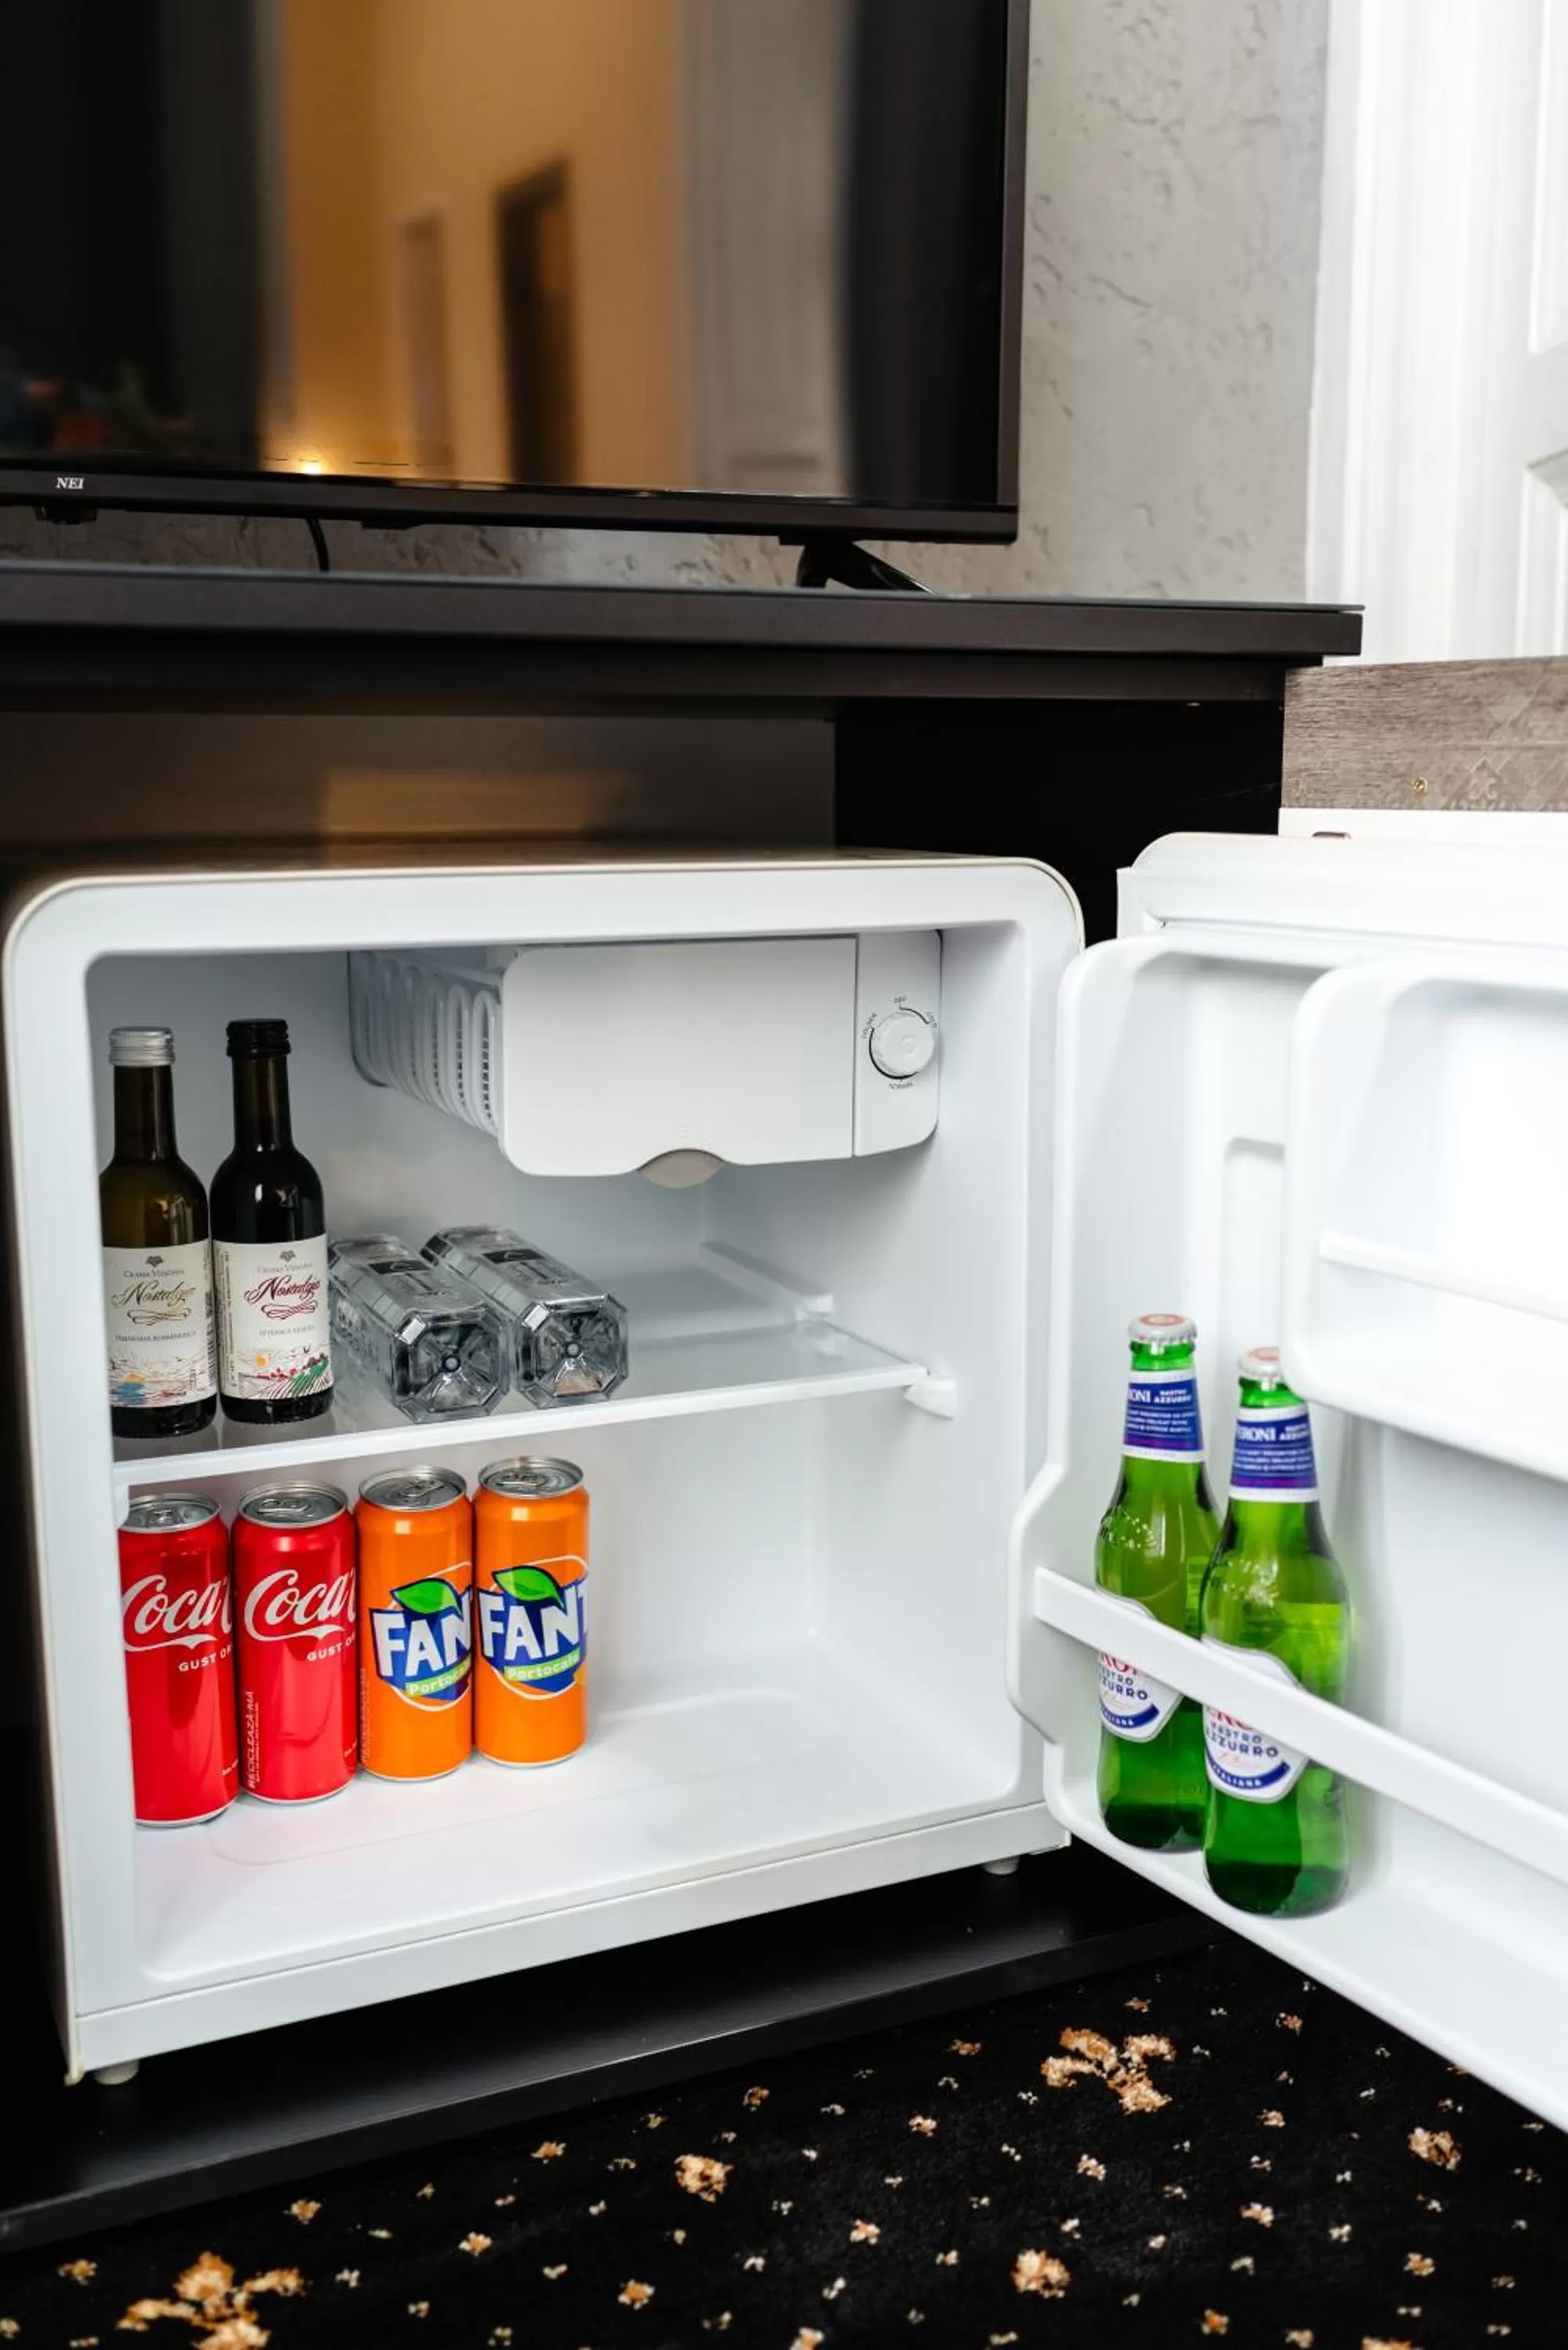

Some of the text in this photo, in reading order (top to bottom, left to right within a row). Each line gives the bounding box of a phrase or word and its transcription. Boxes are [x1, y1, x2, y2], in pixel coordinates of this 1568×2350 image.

[56, 476, 85, 490] NEI
[372, 1590, 472, 1677] FAN
[306, 1642, 343, 1661] GUST
[179, 1652, 217, 1672] GUST
